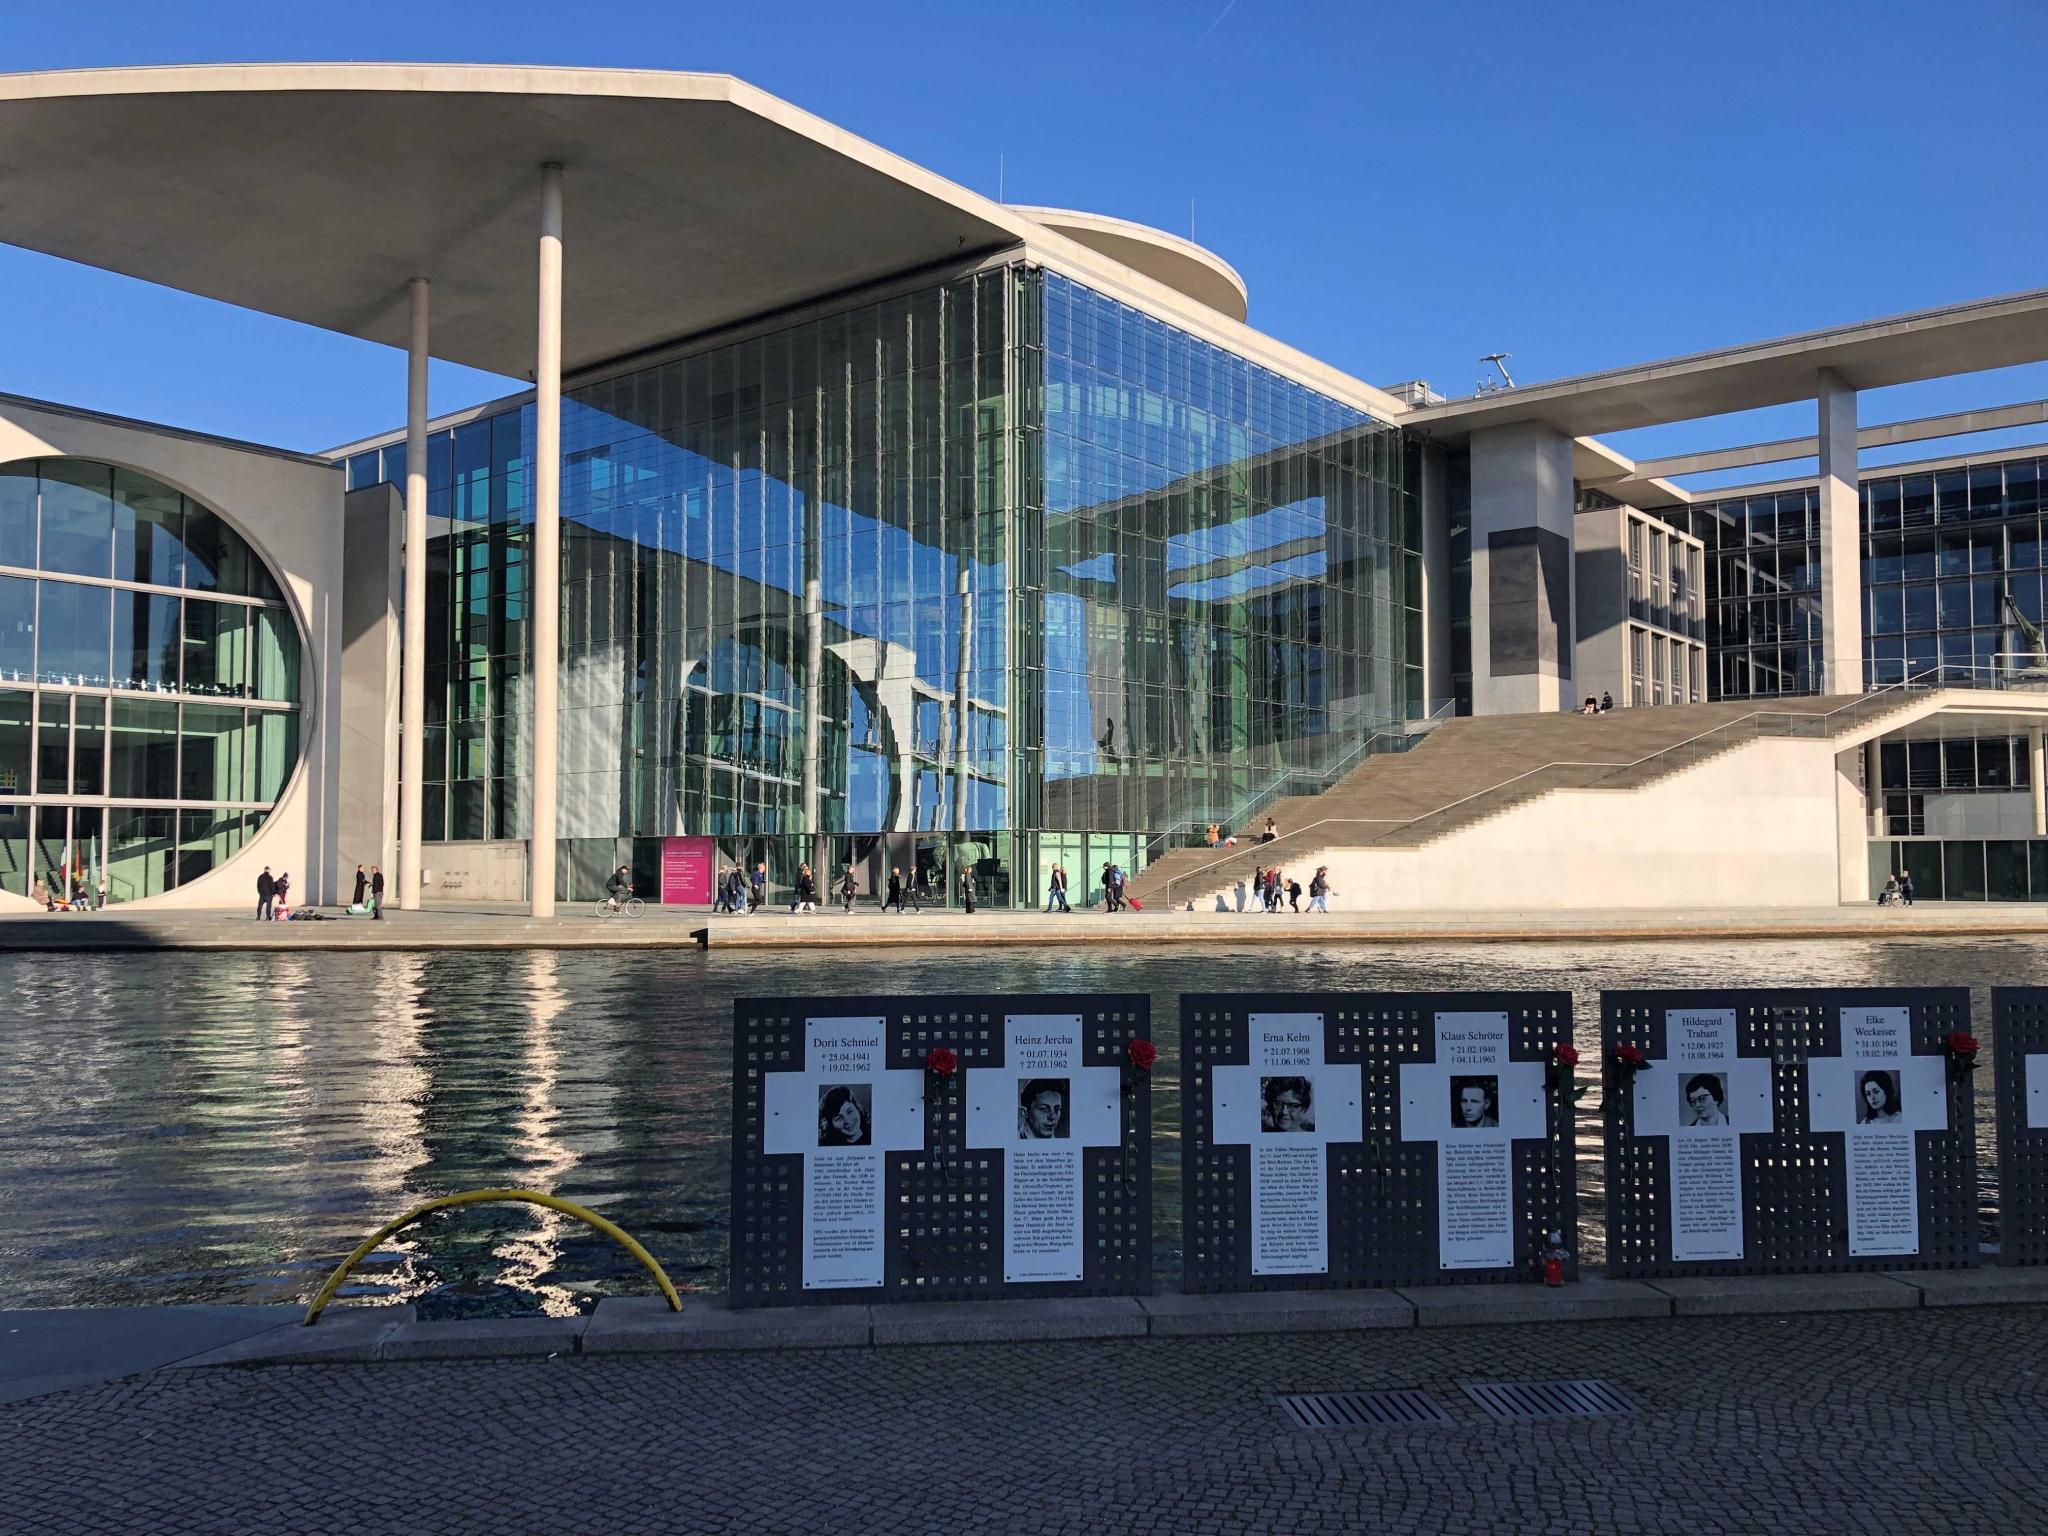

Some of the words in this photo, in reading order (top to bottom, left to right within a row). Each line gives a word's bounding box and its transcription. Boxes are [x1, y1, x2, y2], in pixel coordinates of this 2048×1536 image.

[1682, 1017, 1722, 1027] Hildegard
[1866, 1016, 1884, 1024] Elke
[1441, 1032, 1466, 1040] Klaus
[1468, 1031, 1504, 1040] Schröter
[1686, 1030, 1718, 1038] Trabant
[1855, 1027, 1896, 1036] Weckeiser
[1015, 1035, 1042, 1044] Heinz
[1044, 1035, 1073, 1044] Jercha
[1264, 1033, 1284, 1042] Erna
[1287, 1032, 1310, 1042] Kelm
[814, 1038, 838, 1048] Dorit
[840, 1037, 878, 1047] Schmiel
[828, 1053, 870, 1061] 25.04.1941
[1026, 1050, 1067, 1058] 01.07.1934
[1026, 1061, 1067, 1069] 27.03.1962
[1271, 1058, 1310, 1066] 11.06.1962
[829, 1063, 871, 1072] 19.02.1962
